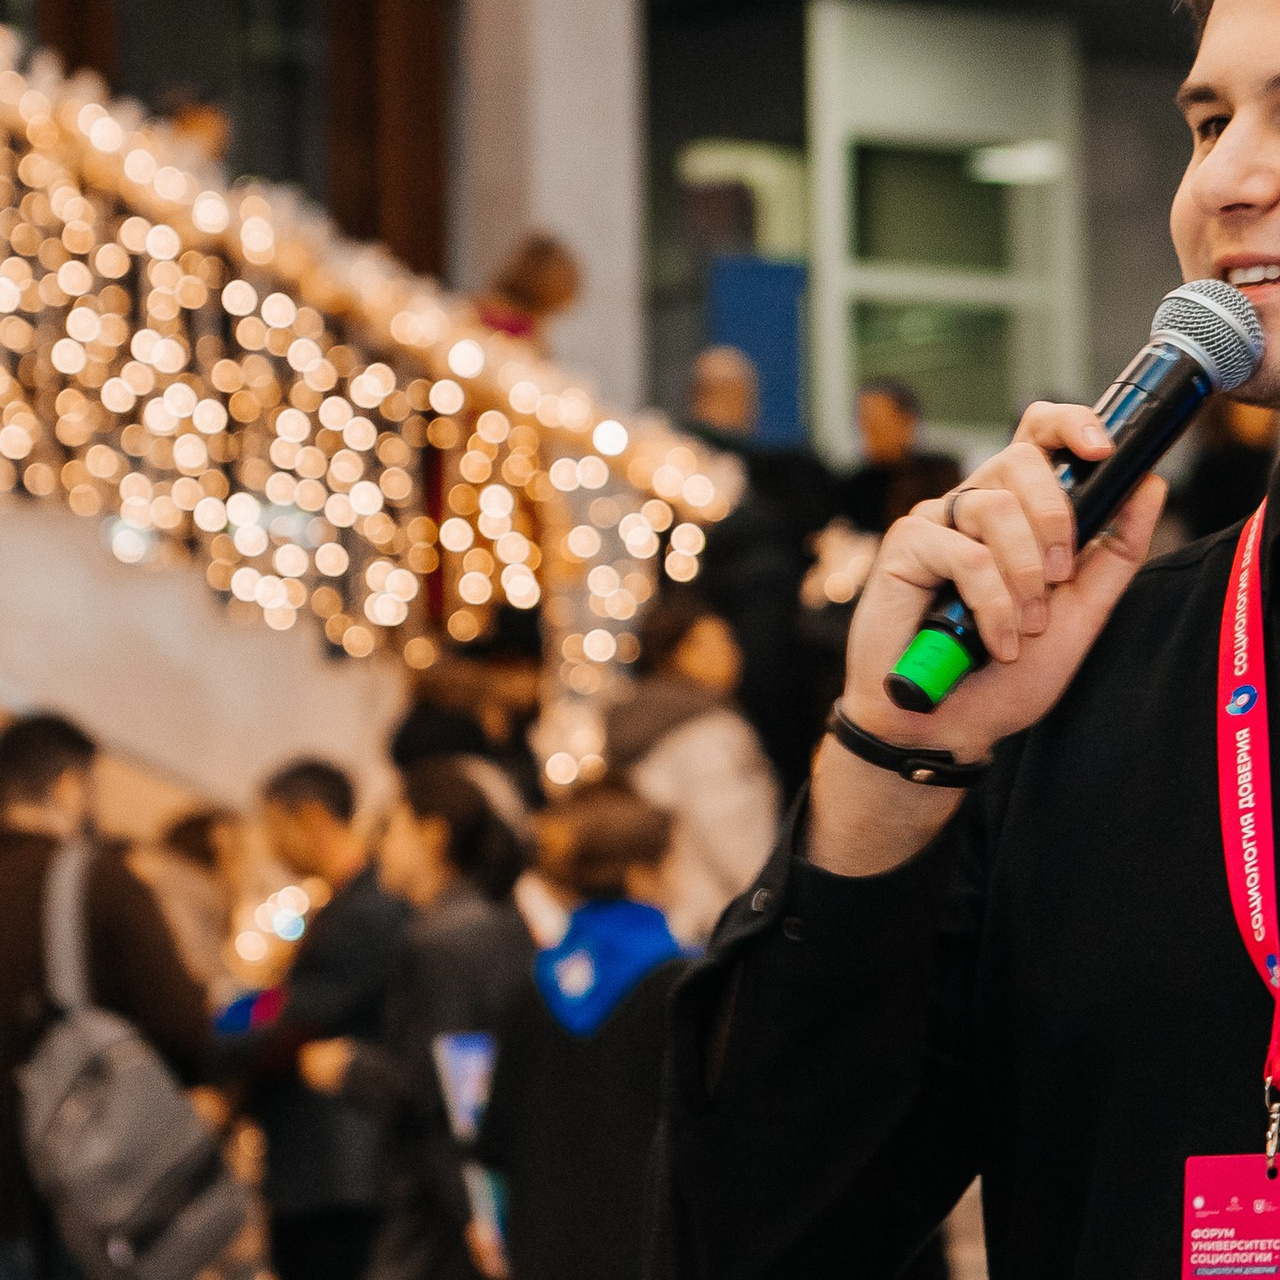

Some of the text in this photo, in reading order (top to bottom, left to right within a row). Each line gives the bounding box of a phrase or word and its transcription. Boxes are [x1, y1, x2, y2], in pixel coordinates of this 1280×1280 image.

[1234, 567, 1249, 677] СОЦИОЛОГИЯ
[1235, 727, 1266, 942] СОЦИОЛОГИЯ ДОВЕРИЯ
[1190, 1252, 1272, 1265] СОЦИОЛОГИИ
[1191, 1228, 1235, 1239] ФОРУМ
